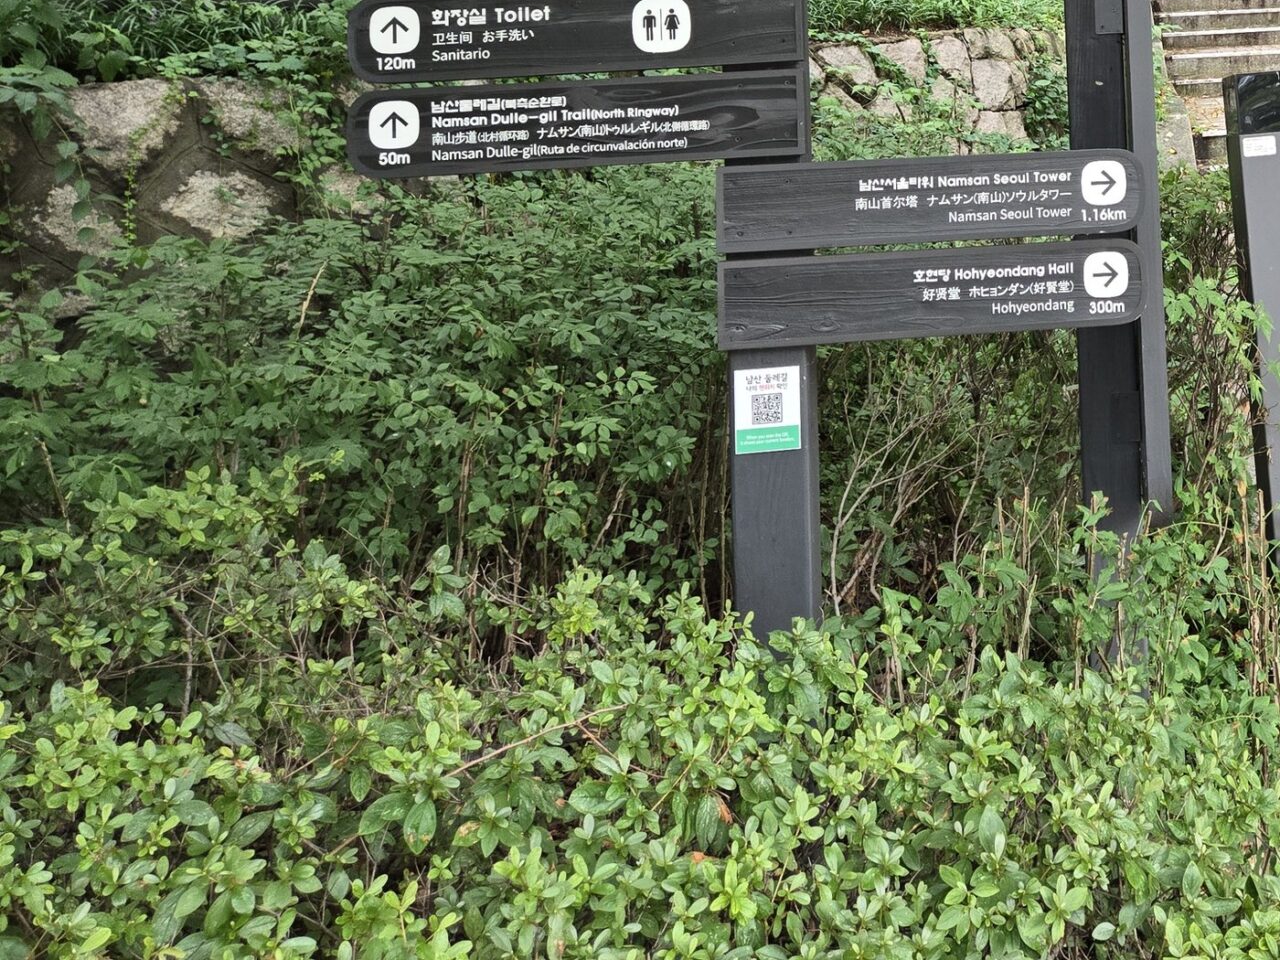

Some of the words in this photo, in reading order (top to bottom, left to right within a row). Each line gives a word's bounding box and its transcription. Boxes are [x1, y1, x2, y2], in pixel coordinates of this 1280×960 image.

[432, 8, 486, 26] 화장실
[495, 6, 550, 23] Toilet
[432, 32, 472, 45] 卫生间
[483, 29, 534, 42] お手洗い
[432, 49, 490, 61] Sanitario
[377, 57, 415, 70] 120m
[432, 117, 487, 128] Namsan
[432, 150, 483, 160] Namsan
[567, 144, 580, 153] de
[581, 139, 655, 152] circunvalación
[657, 137, 687, 148] norte)
[379, 152, 410, 165] 50m
[938, 176, 989, 187] Namsan
[994, 173, 1029, 184] Seoul
[1034, 171, 1071, 182] Tower
[856, 195, 918, 210] 南山首尔塔
[949, 212, 997, 222] Namsan
[1000, 207, 1033, 220] Seoul
[1036, 207, 1072, 218] Tower
[1082, 208, 1126, 221] 1.16km
[955, 265, 1045, 280] Hohyeondang
[1049, 262, 1073, 274] Hall
[923, 287, 960, 301] 好贤堂
[992, 299, 1074, 315] Hohyeondang
[1089, 301, 1124, 314] 300m
